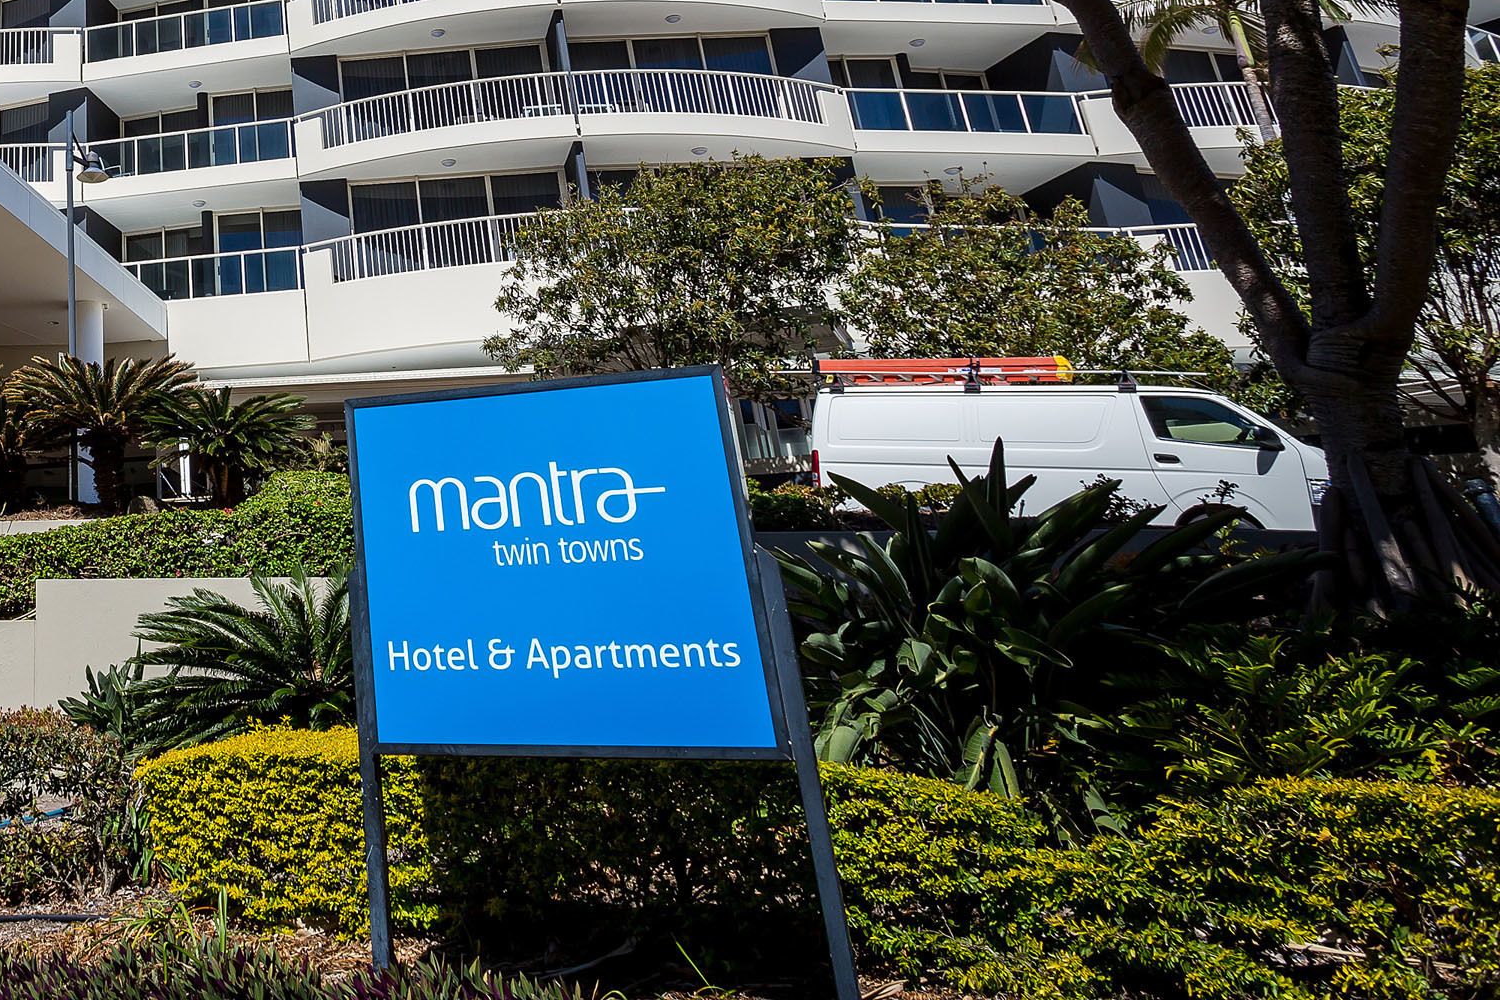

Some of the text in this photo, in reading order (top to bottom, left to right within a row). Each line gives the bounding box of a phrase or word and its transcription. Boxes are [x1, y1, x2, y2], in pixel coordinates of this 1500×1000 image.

[409, 461, 666, 533] mantra
[492, 537, 644, 566] twin towns
[388, 637, 741, 679] Hotel & Apartments
